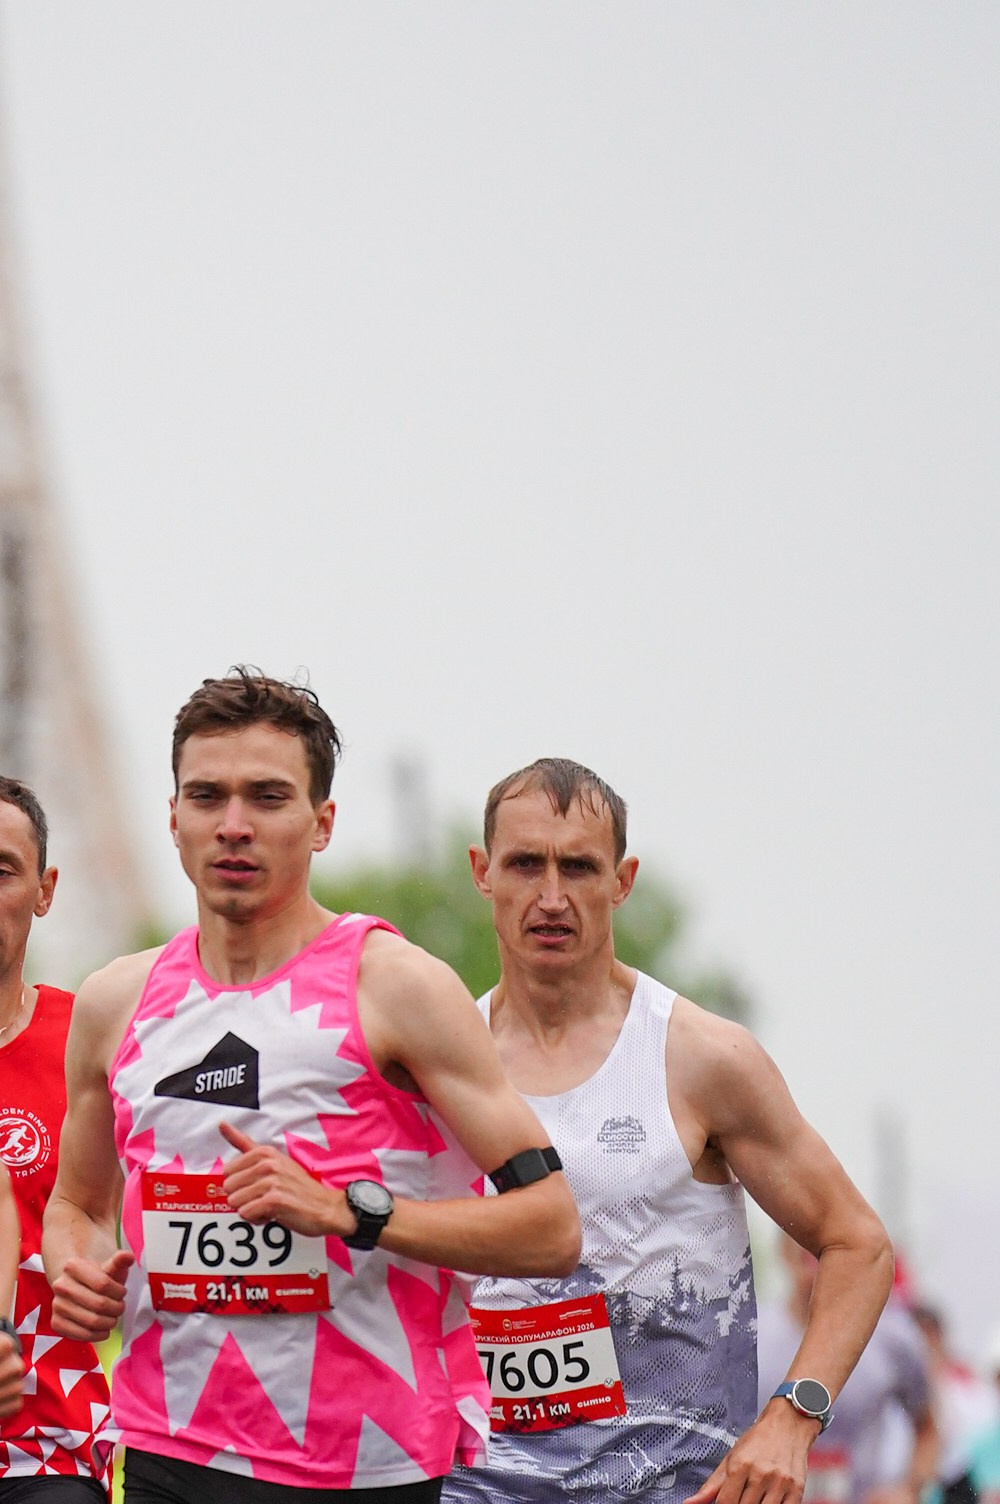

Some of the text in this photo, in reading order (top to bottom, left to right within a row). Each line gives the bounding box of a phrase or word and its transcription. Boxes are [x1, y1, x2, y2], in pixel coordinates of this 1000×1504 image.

[194, 1063, 247, 1094] STRIDE
[26, 1111, 48, 1134] RING
[15, 1162, 44, 1178] TRAIL
[168, 1220, 293, 1267] 7639
[206, 1282, 242, 1302] 21,1
[475, 1322, 595, 1343] АРИЖСКИЙ ПОЛУМАРАФОН 2026
[478, 1340, 590, 1393] 7605
[512, 1403, 546, 1421] 21,1
